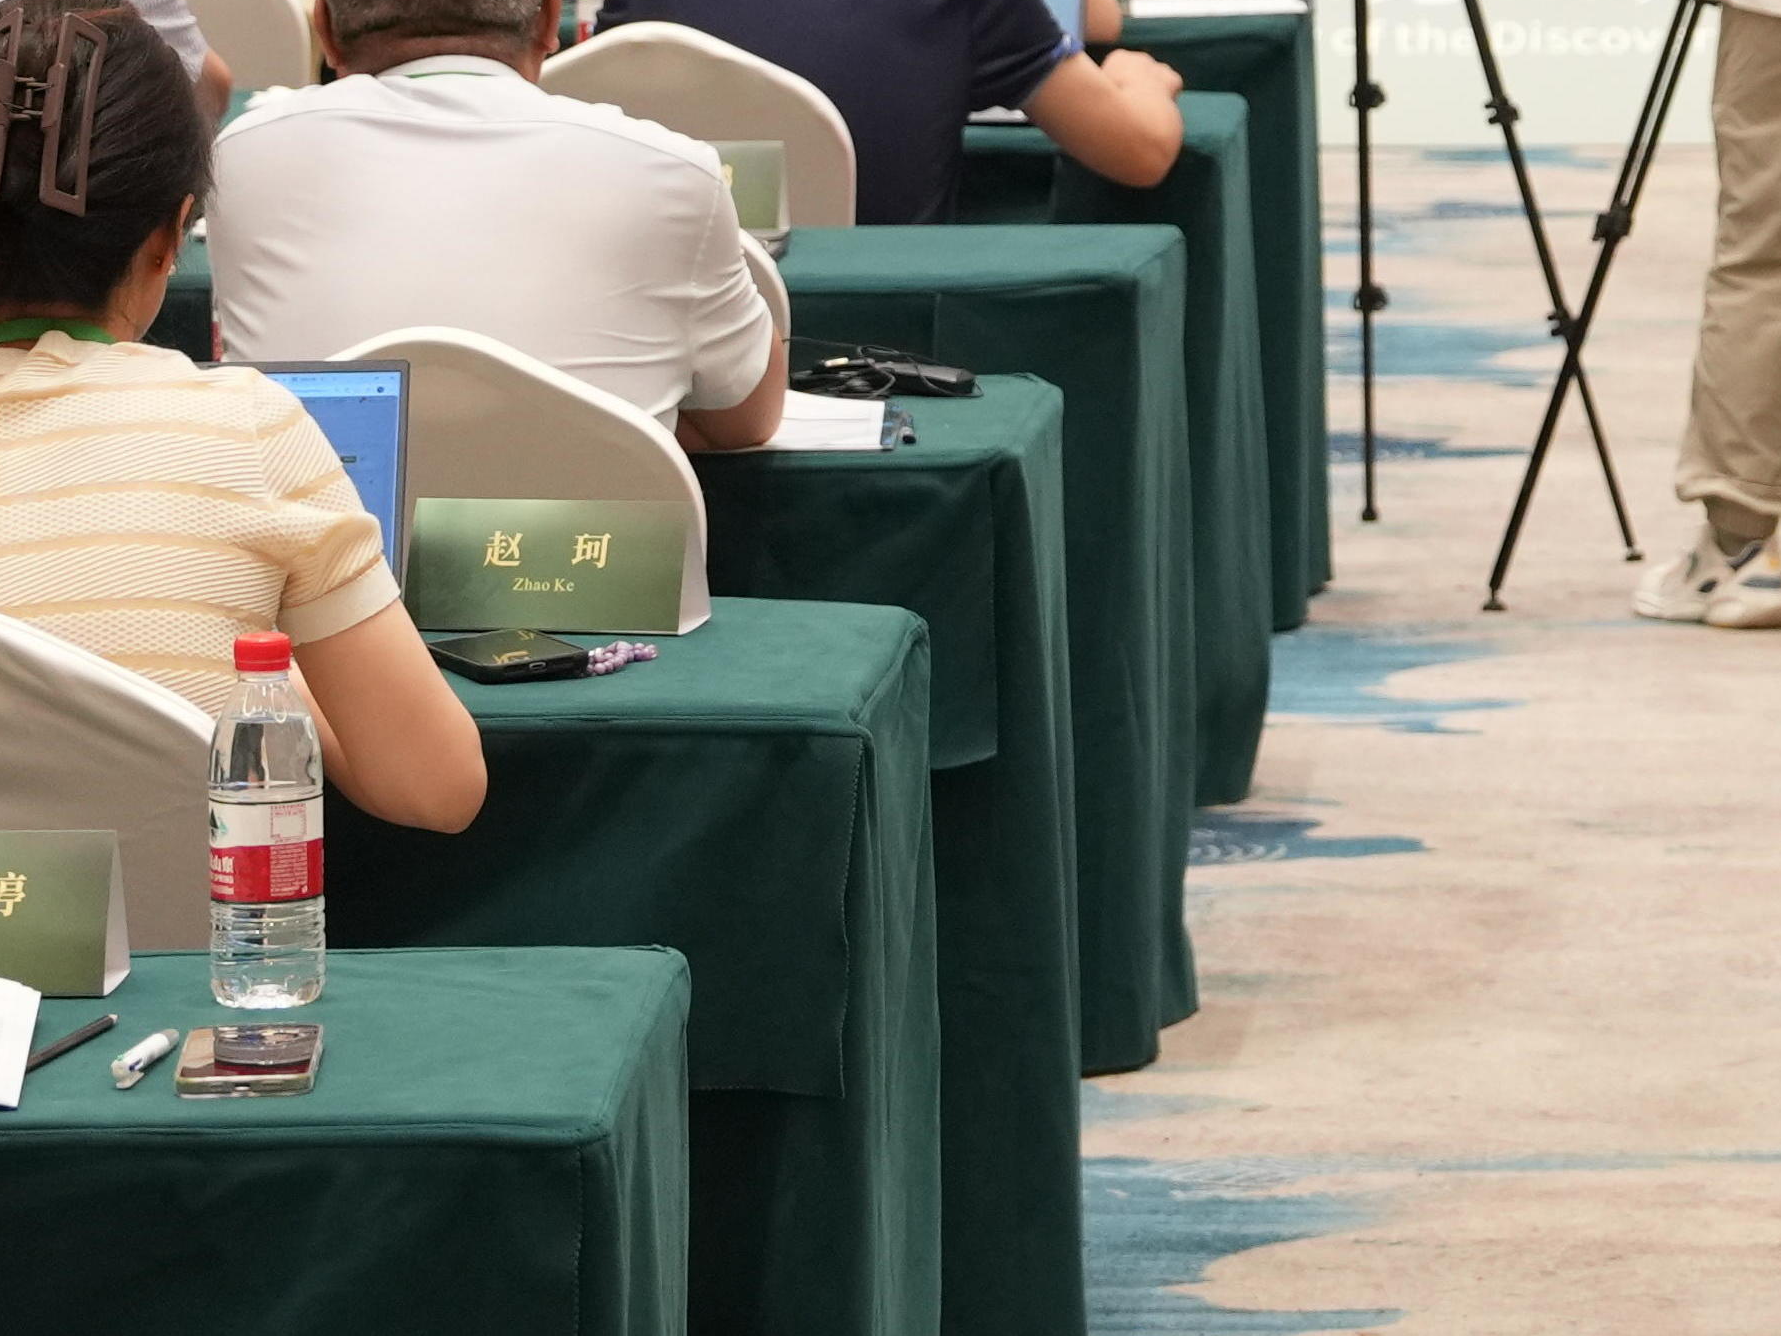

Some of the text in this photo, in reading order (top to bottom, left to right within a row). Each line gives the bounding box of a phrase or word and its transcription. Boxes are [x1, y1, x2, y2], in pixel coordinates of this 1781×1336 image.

[1394, 18, 1472, 57] the
[482, 530, 612, 569] 赵珂
[512, 577, 576, 592] Zhao Ke
